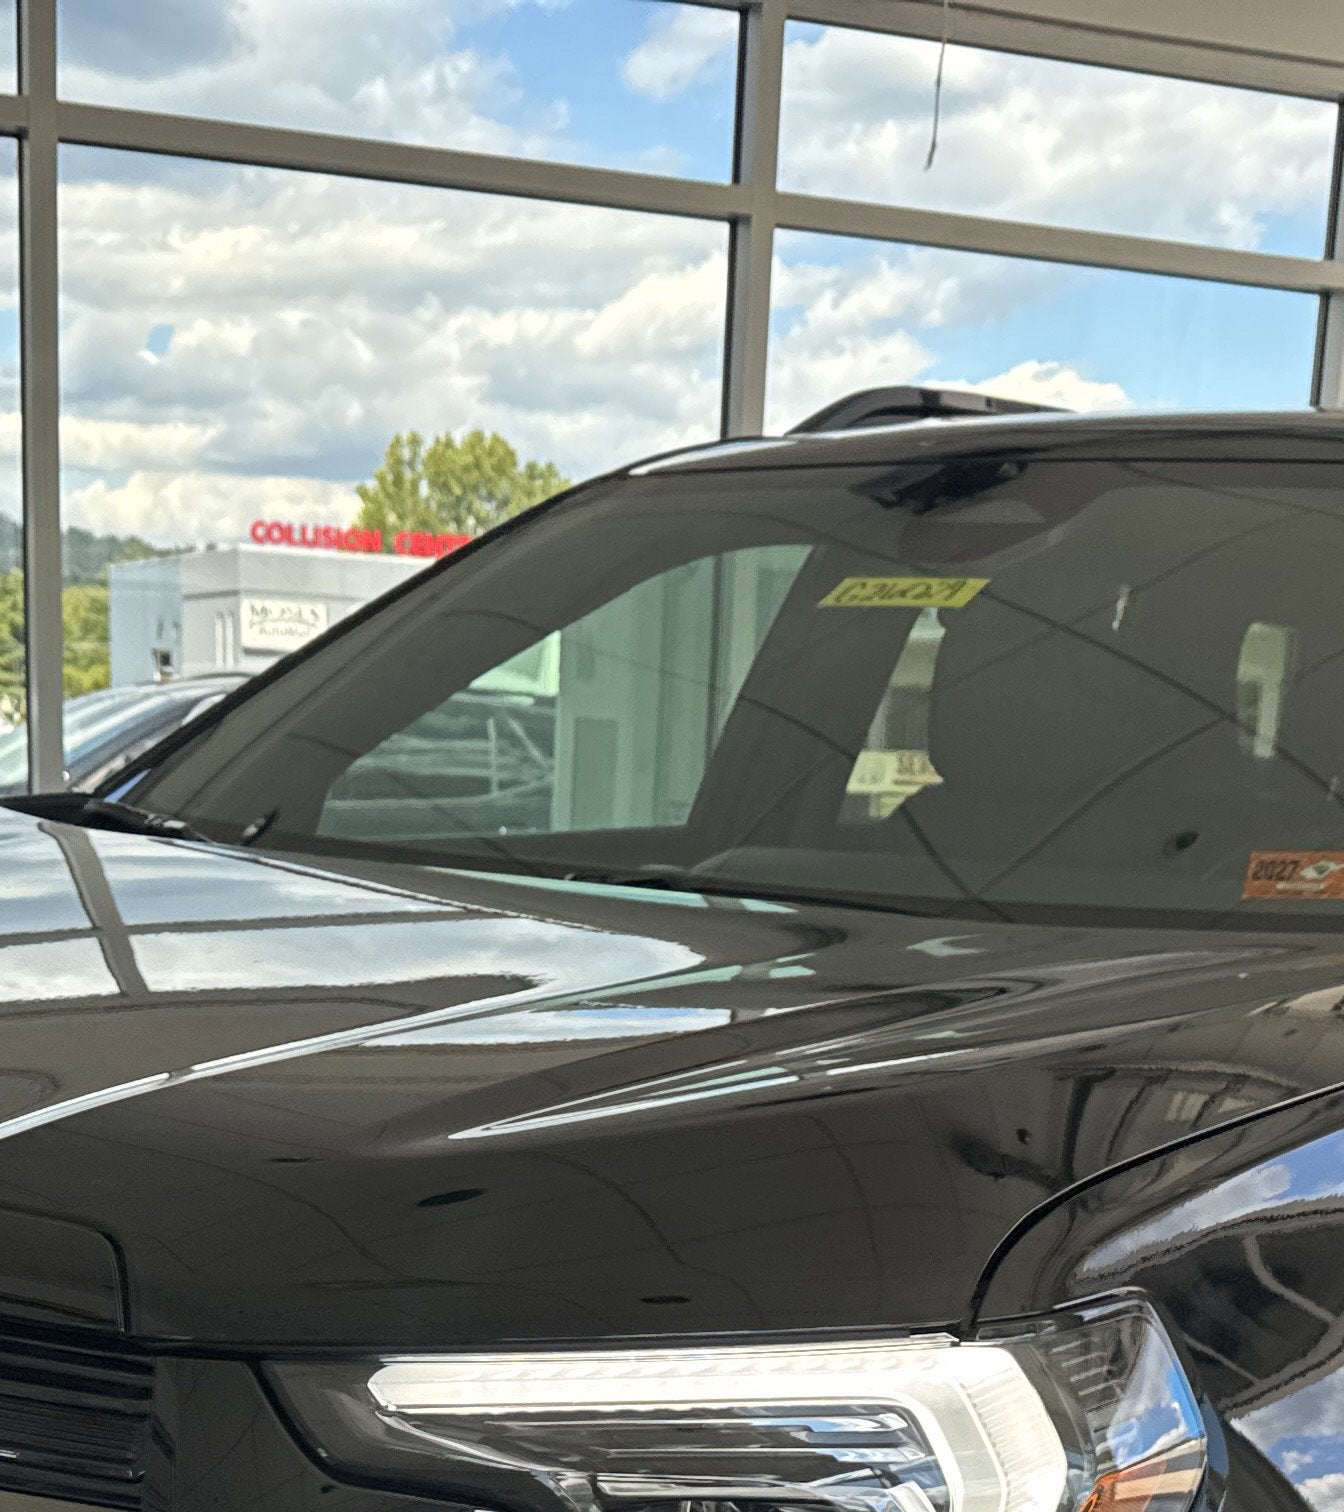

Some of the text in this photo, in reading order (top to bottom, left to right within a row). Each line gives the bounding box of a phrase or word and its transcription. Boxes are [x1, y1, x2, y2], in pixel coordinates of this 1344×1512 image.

[250, 520, 472, 558] COLLISION CENT
[1252, 860, 1301, 882] 2027
